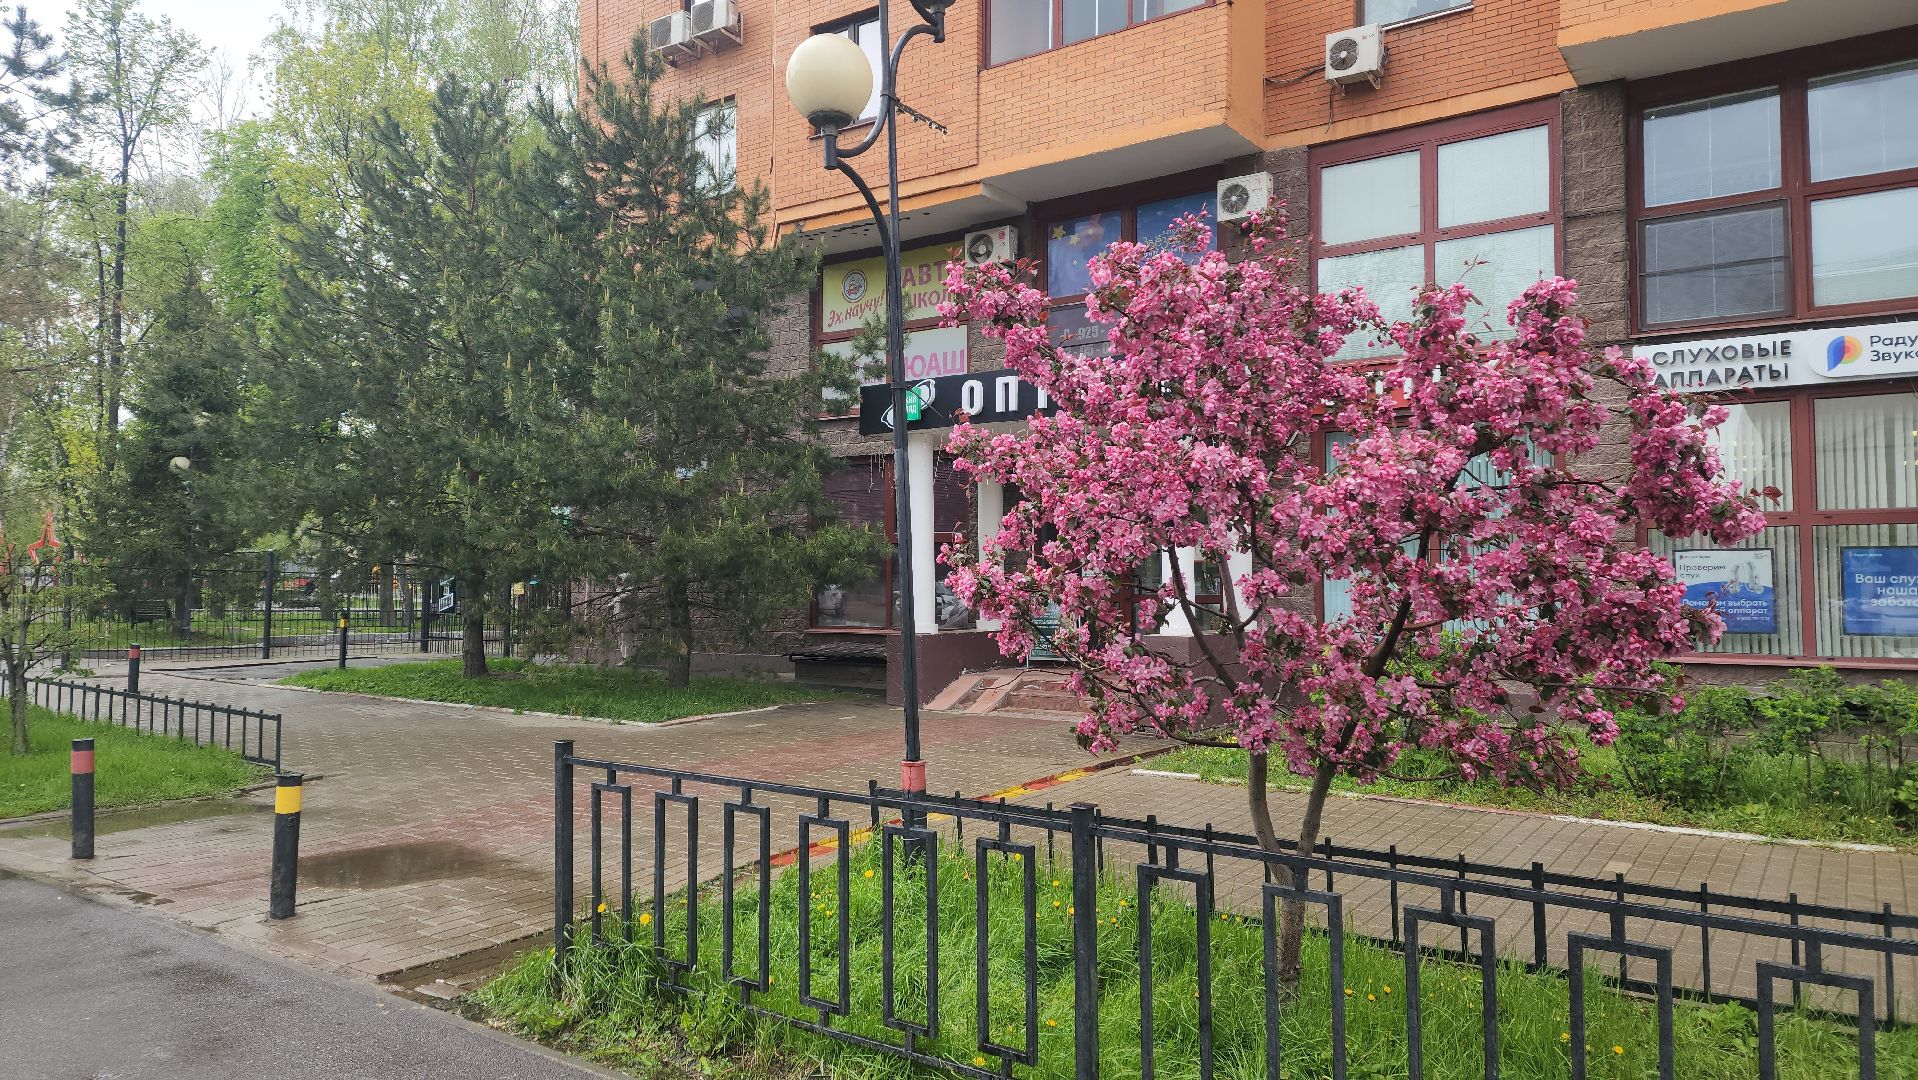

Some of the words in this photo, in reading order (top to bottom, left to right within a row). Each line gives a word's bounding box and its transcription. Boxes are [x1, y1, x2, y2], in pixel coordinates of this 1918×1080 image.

[828, 309, 844, 328] Эх,
[845, 288, 886, 319] научу!
[1652, 339, 1793, 367] СЛУХОВЫЕ
[1653, 362, 1790, 389] АППАРАТЫ
[1680, 564, 1726, 572] Проверим
[1855, 573, 1886, 584] Ваш
[1877, 586, 1918, 595] наша
[1728, 598, 1768, 608] выбрать
[1728, 608, 1768, 616] аппарат
